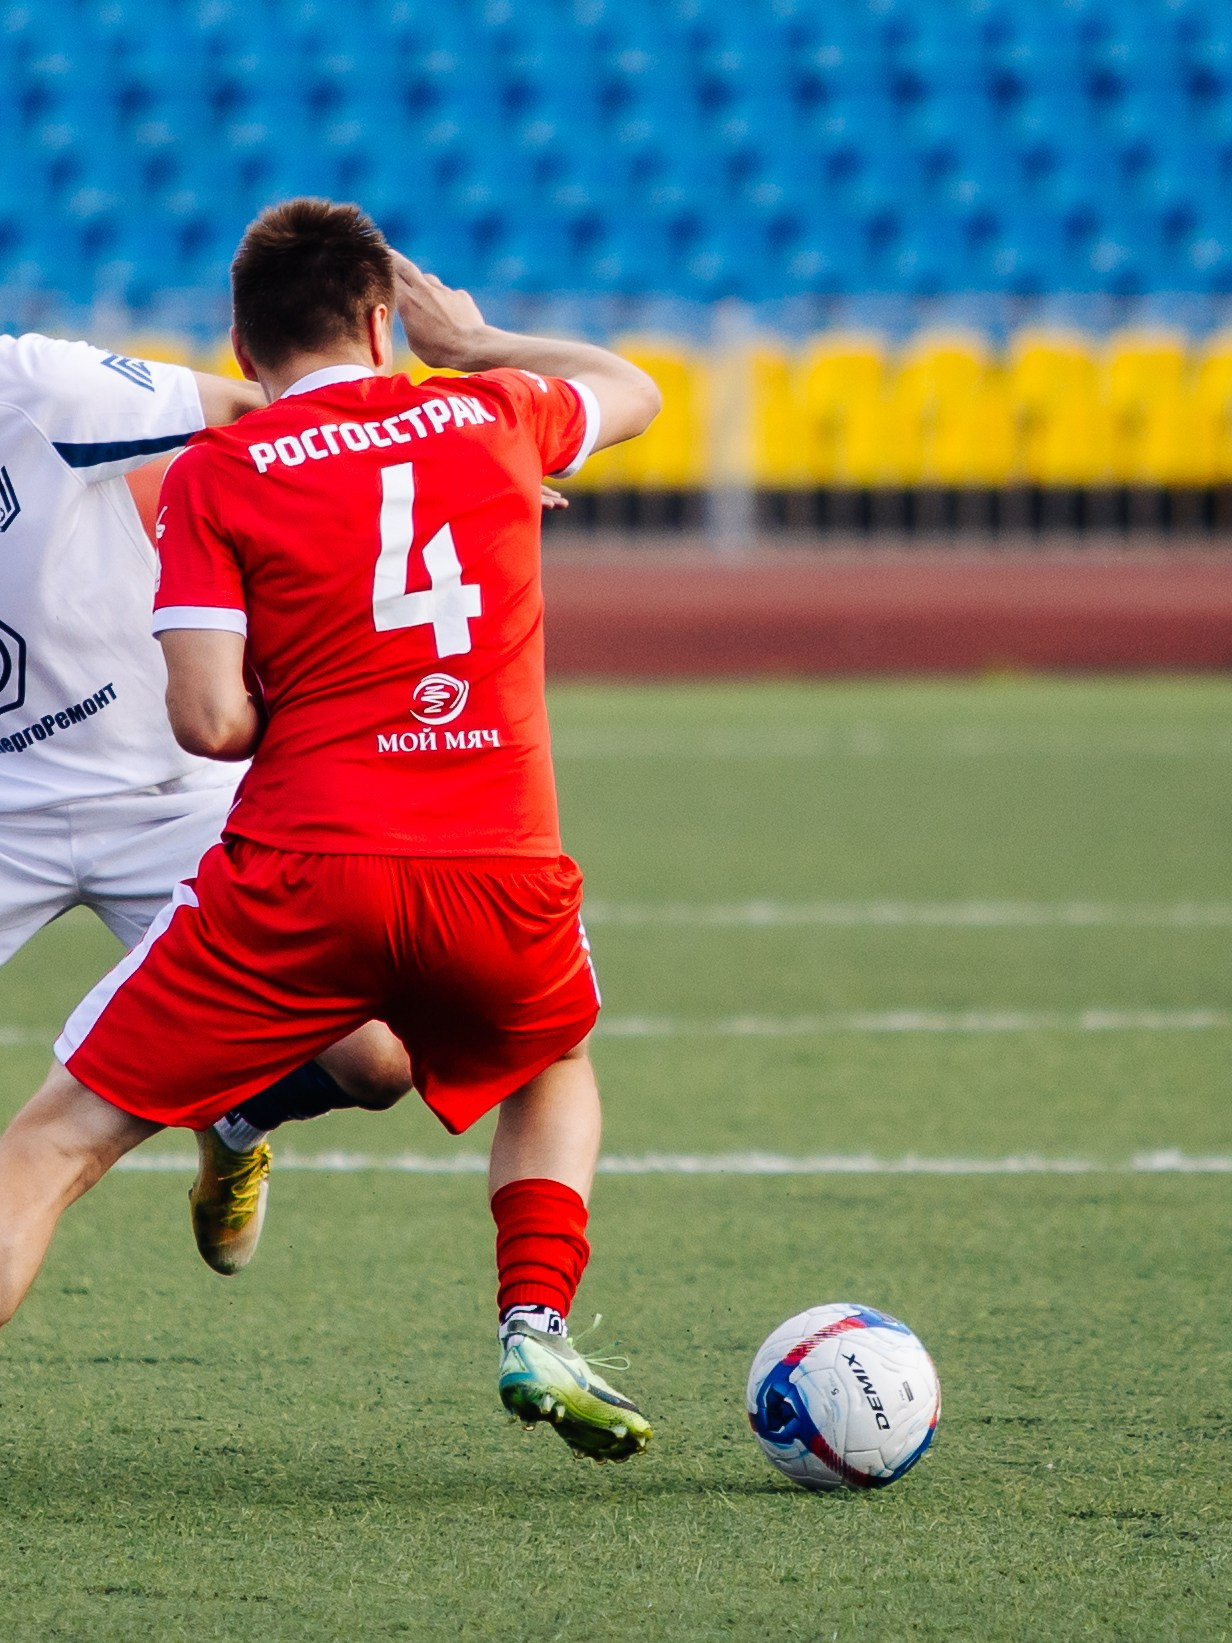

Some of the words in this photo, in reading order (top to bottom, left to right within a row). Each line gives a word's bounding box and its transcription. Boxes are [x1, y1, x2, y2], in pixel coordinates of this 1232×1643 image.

[248, 395, 497, 474] РОСГОССТРАХ
[373, 461, 482, 659] 4
[377, 727, 439, 753] МОЙ
[444, 729, 501, 750] МЯЧ
[841, 1353, 891, 1431] DEMIX
